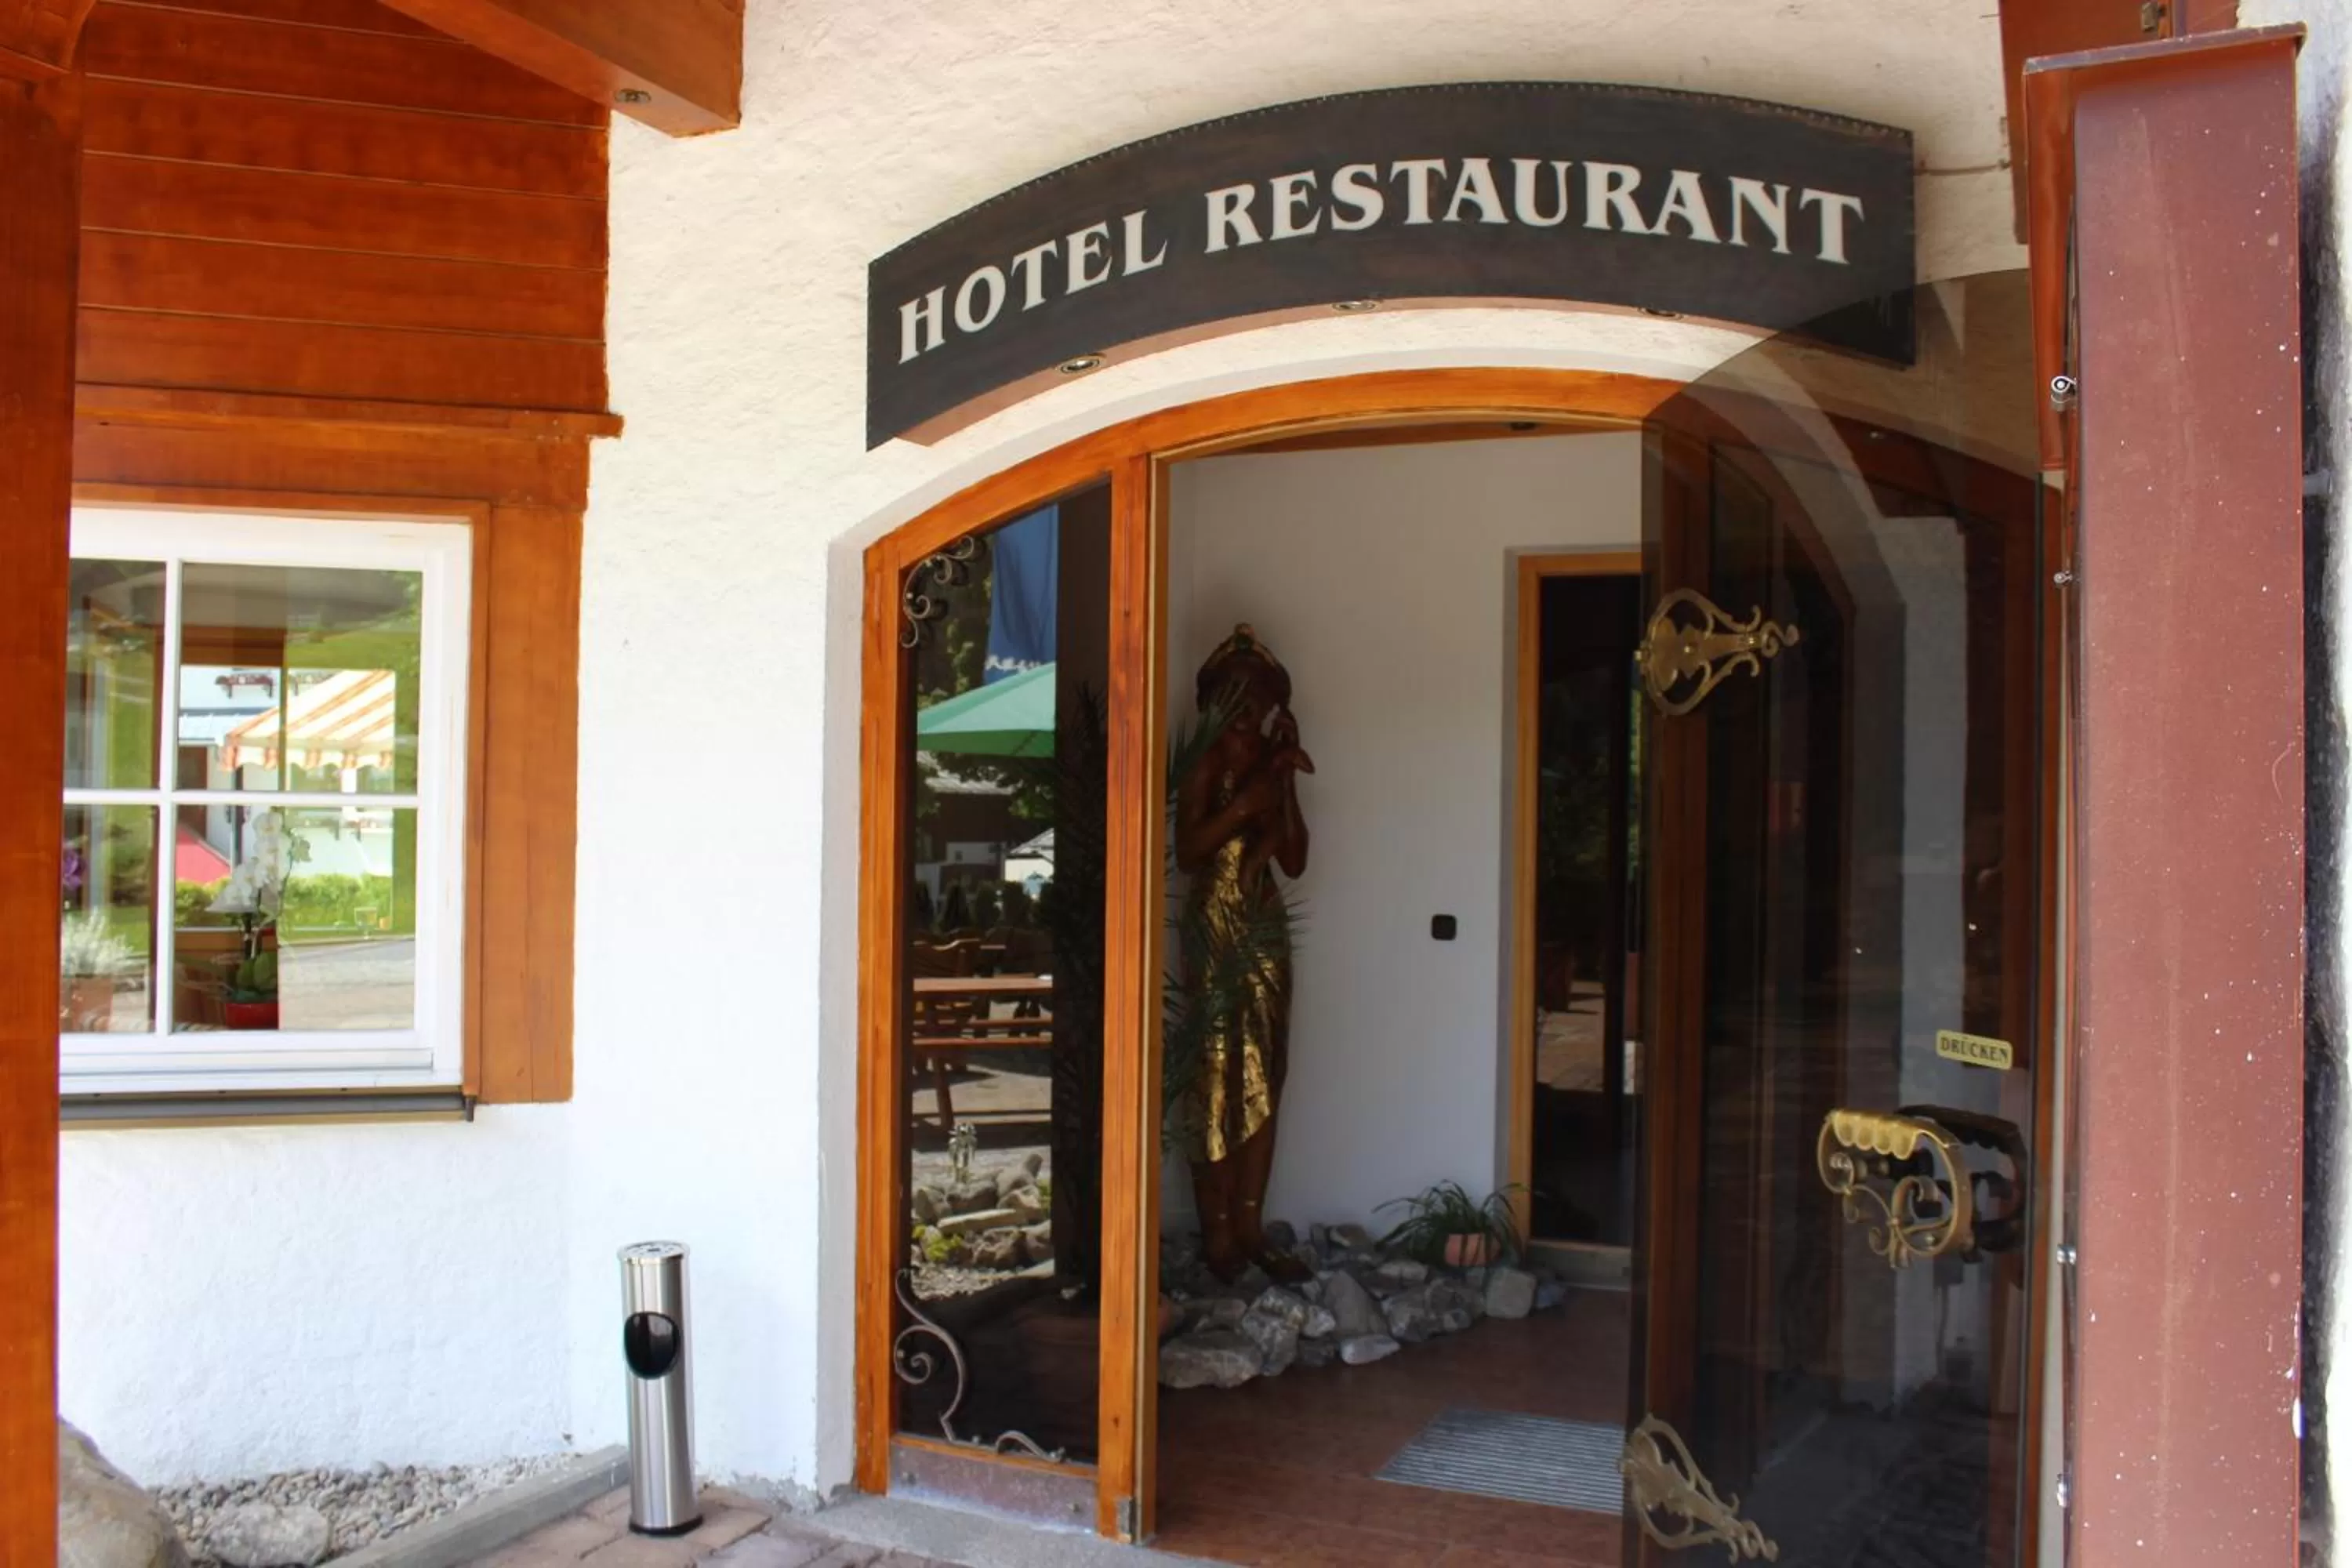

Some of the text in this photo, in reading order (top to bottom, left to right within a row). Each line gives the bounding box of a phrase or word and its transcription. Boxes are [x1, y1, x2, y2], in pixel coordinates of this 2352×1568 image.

[898, 158, 1865, 365] HOTEL RESTAURANT
[1940, 1036, 2009, 1063] DRÜCKEN
